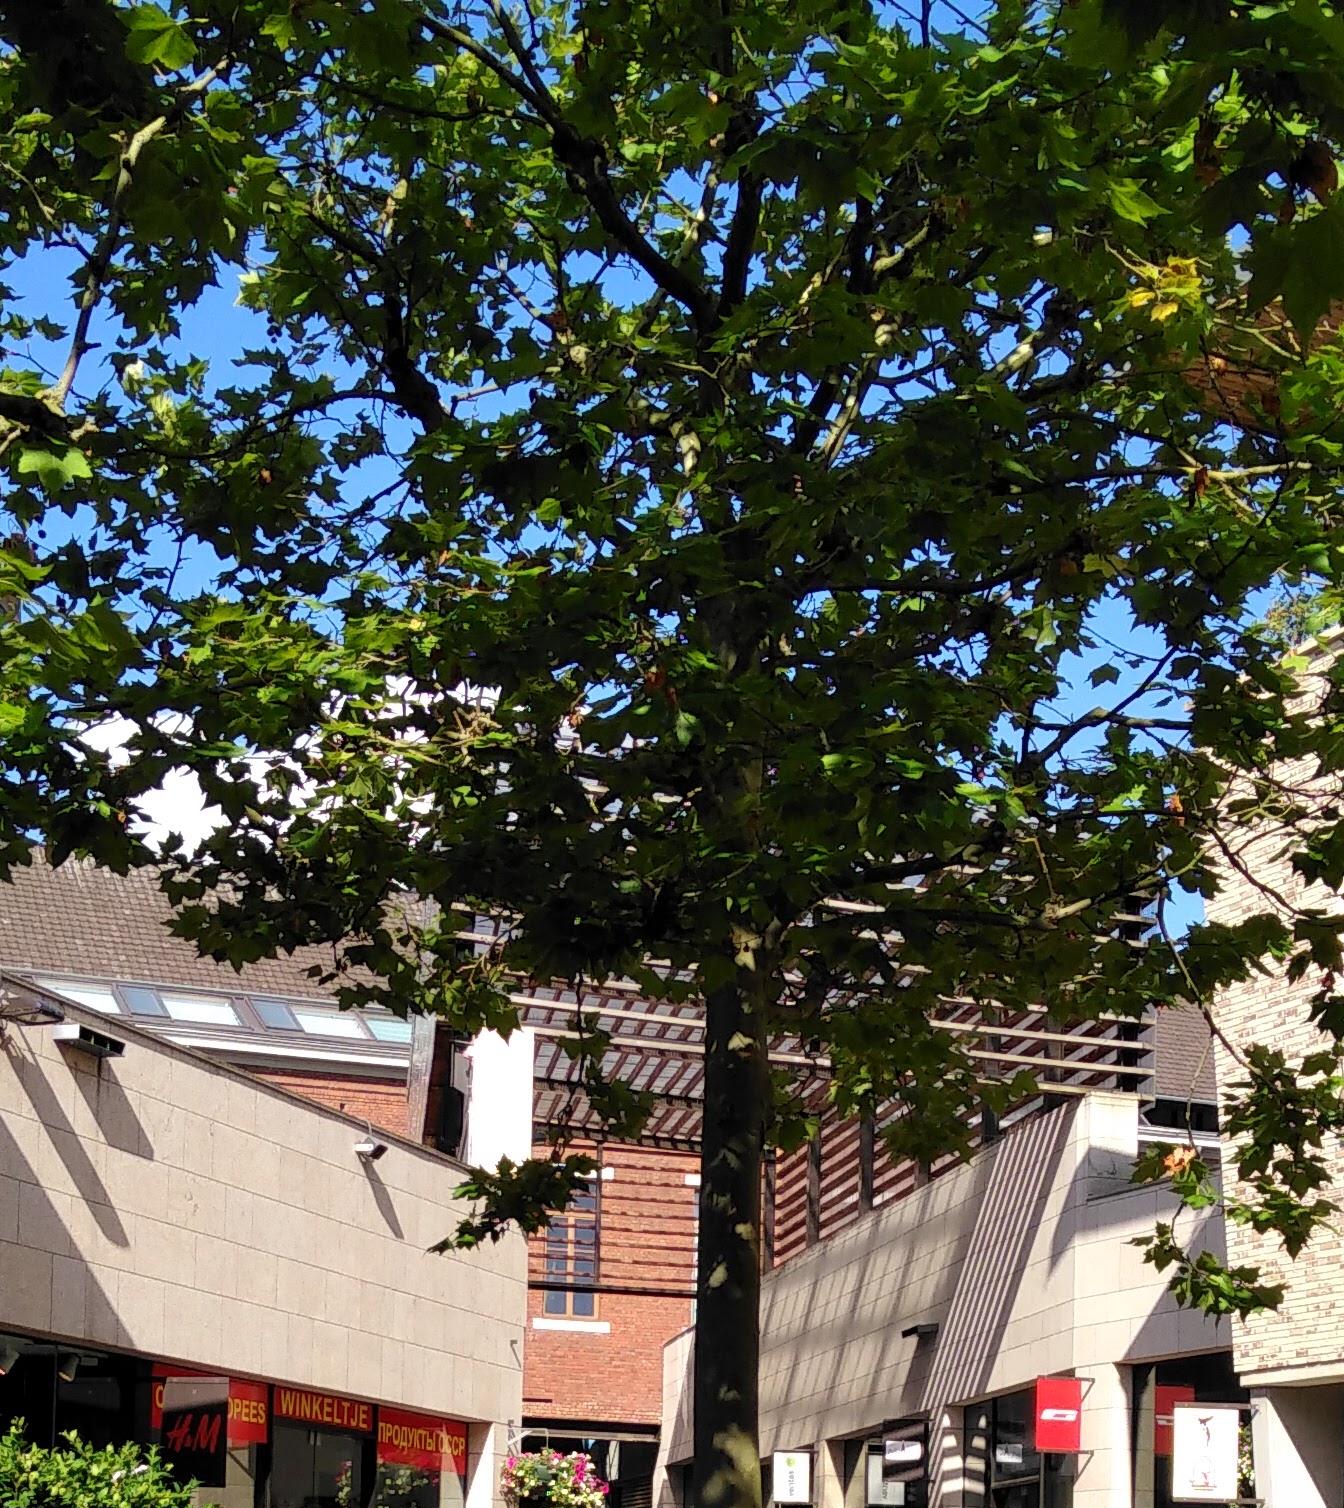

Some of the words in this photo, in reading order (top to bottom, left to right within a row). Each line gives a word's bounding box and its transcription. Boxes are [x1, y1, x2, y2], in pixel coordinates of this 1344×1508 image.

[280, 1388, 369, 1429] WINKELTJE
[167, 1414, 222, 1454] H&M
[378, 1421, 437, 1451] ПРОДУКТЫ
